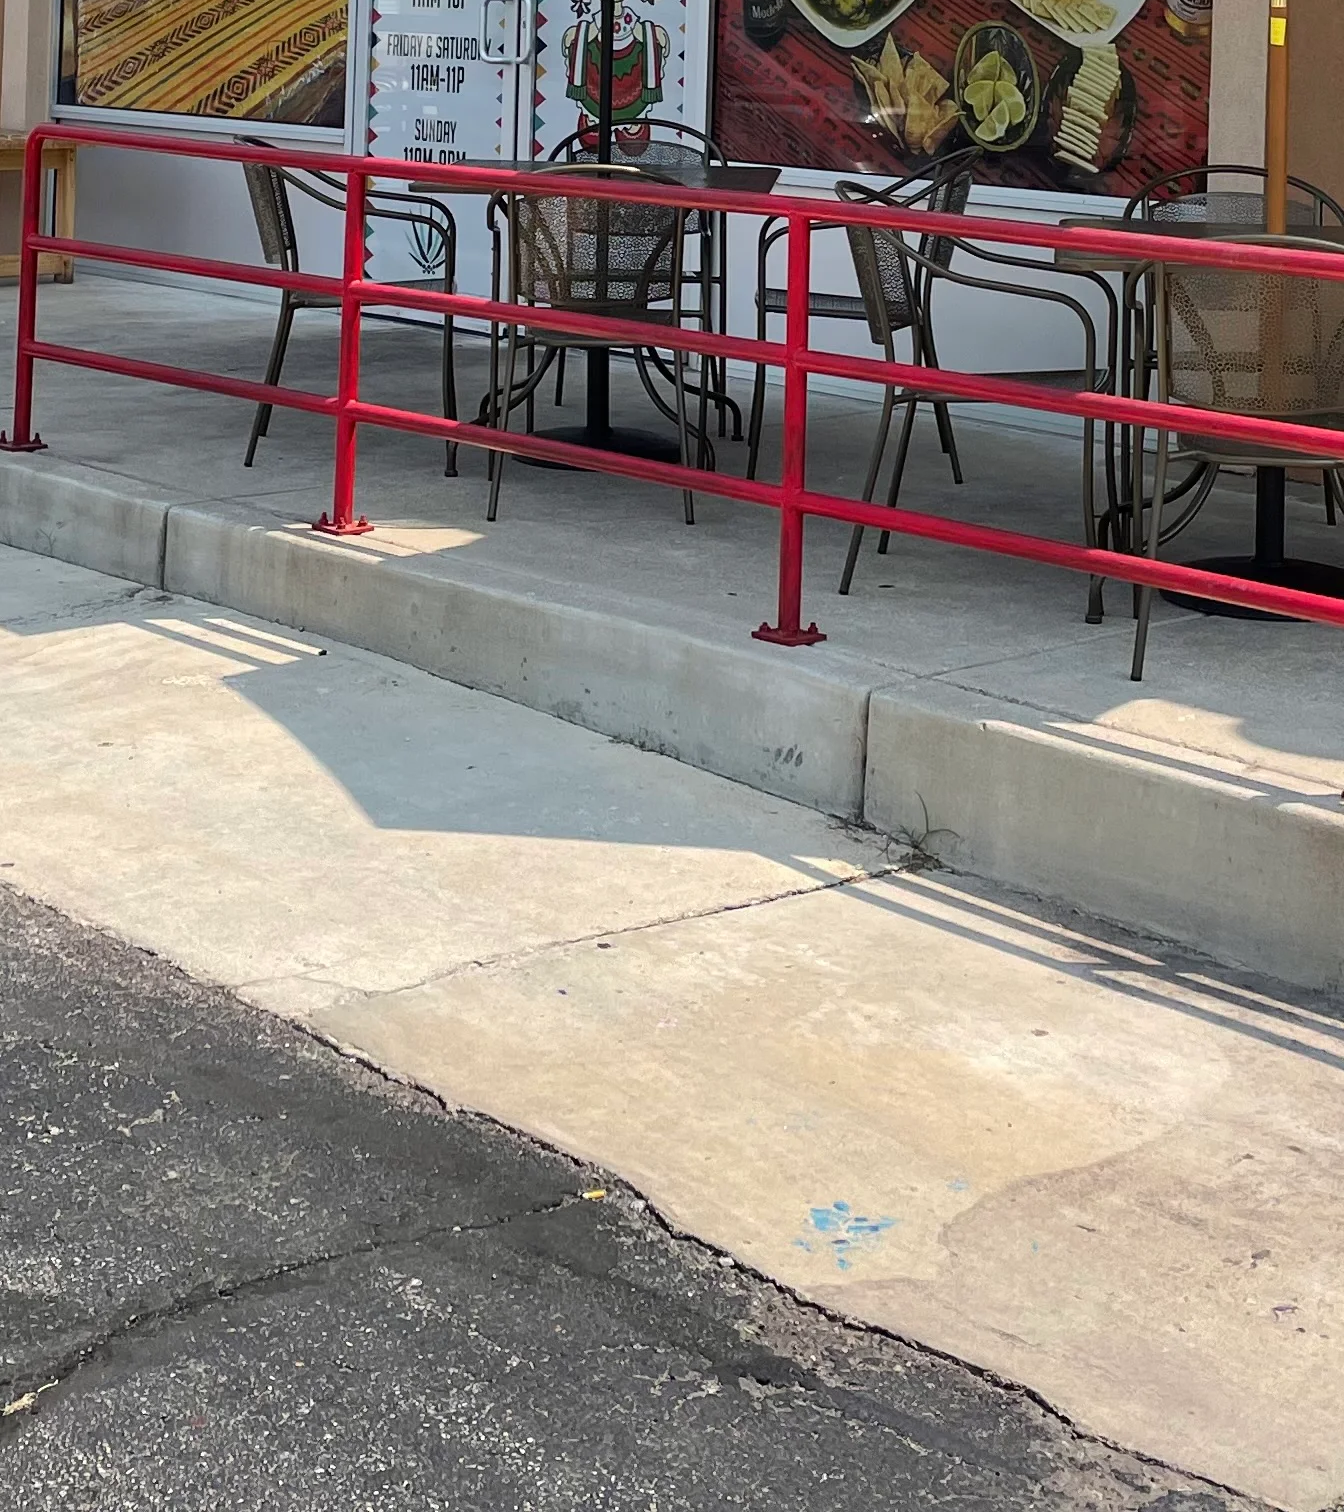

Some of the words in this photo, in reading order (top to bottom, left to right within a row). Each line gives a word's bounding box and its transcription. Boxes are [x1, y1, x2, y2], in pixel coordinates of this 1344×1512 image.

[387, 34, 423, 57] FRIDAY
[426, 36, 432, 58] &
[411, 64, 465, 93] 11AM-11P
[414, 118, 457, 144] SUNDAY
